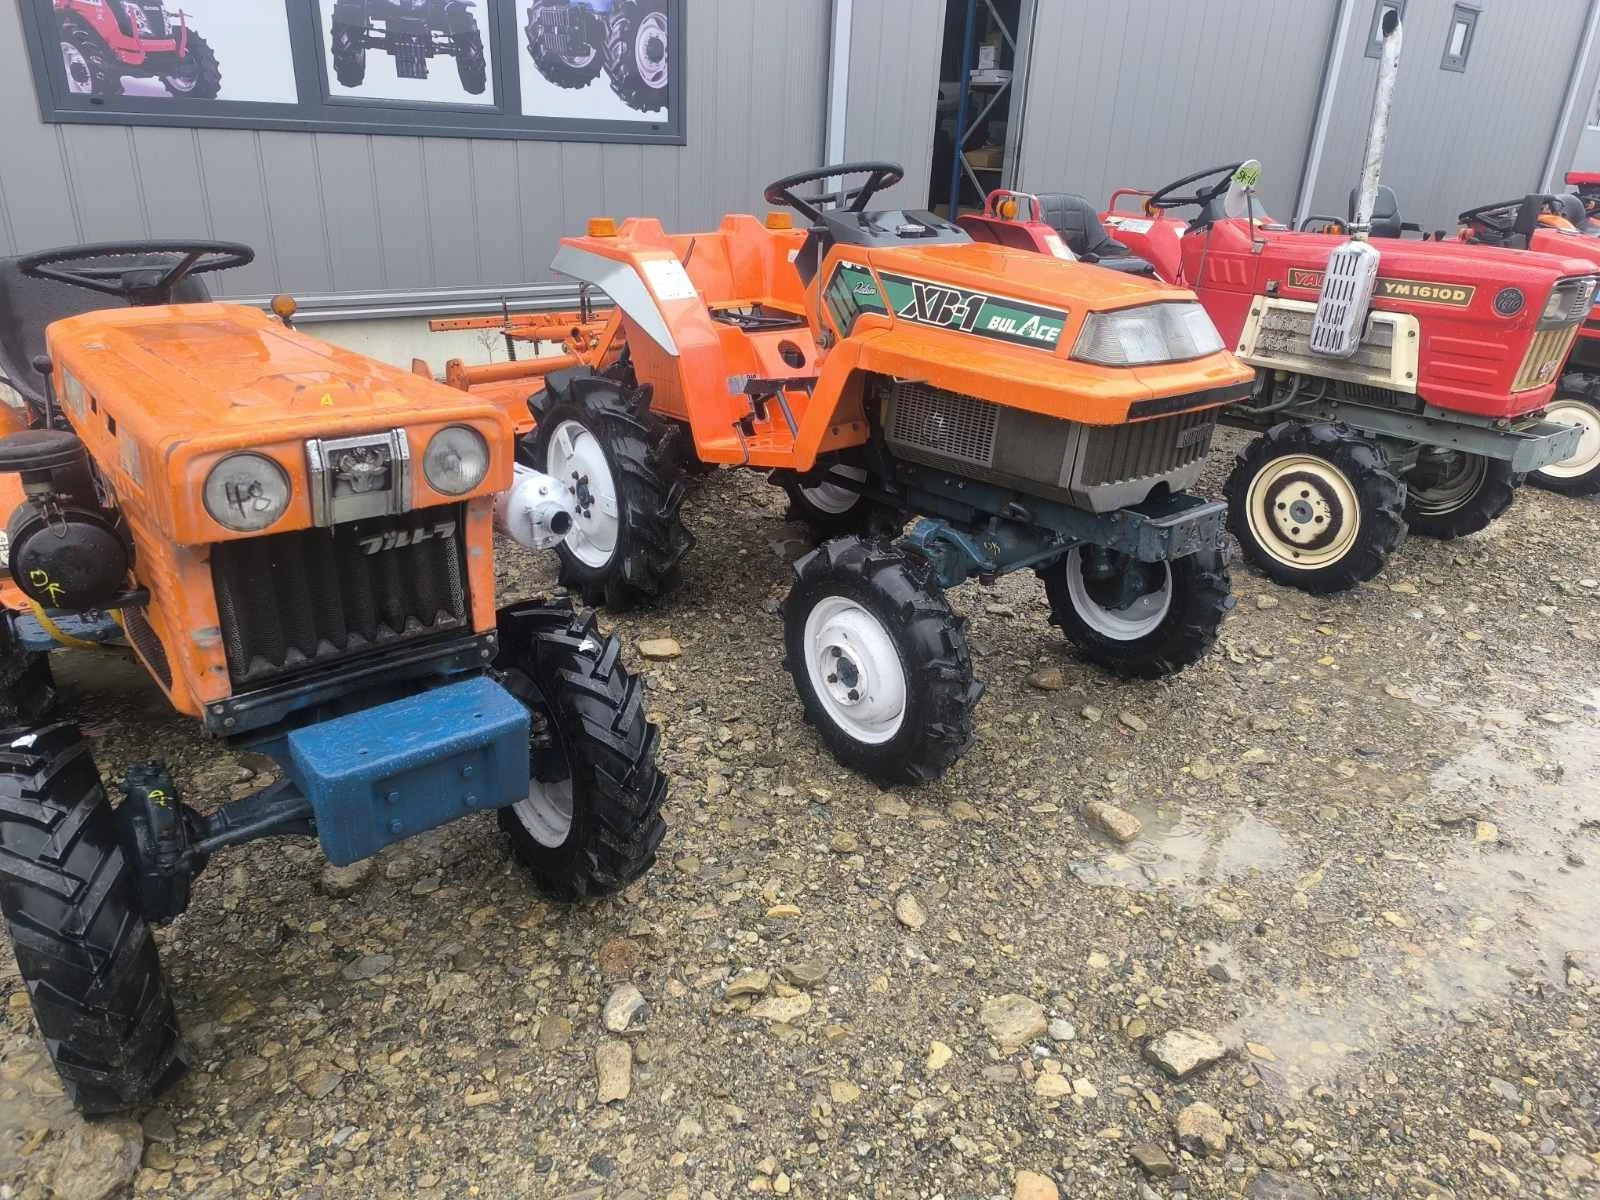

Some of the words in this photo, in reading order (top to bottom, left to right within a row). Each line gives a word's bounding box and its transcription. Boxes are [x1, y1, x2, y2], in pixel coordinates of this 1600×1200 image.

[897, 281, 988, 332] XB-1
[1384, 282, 1466, 301] YM1610D
[987, 315, 1062, 341] BULACE
[359, 520, 457, 556] ブルトラ
